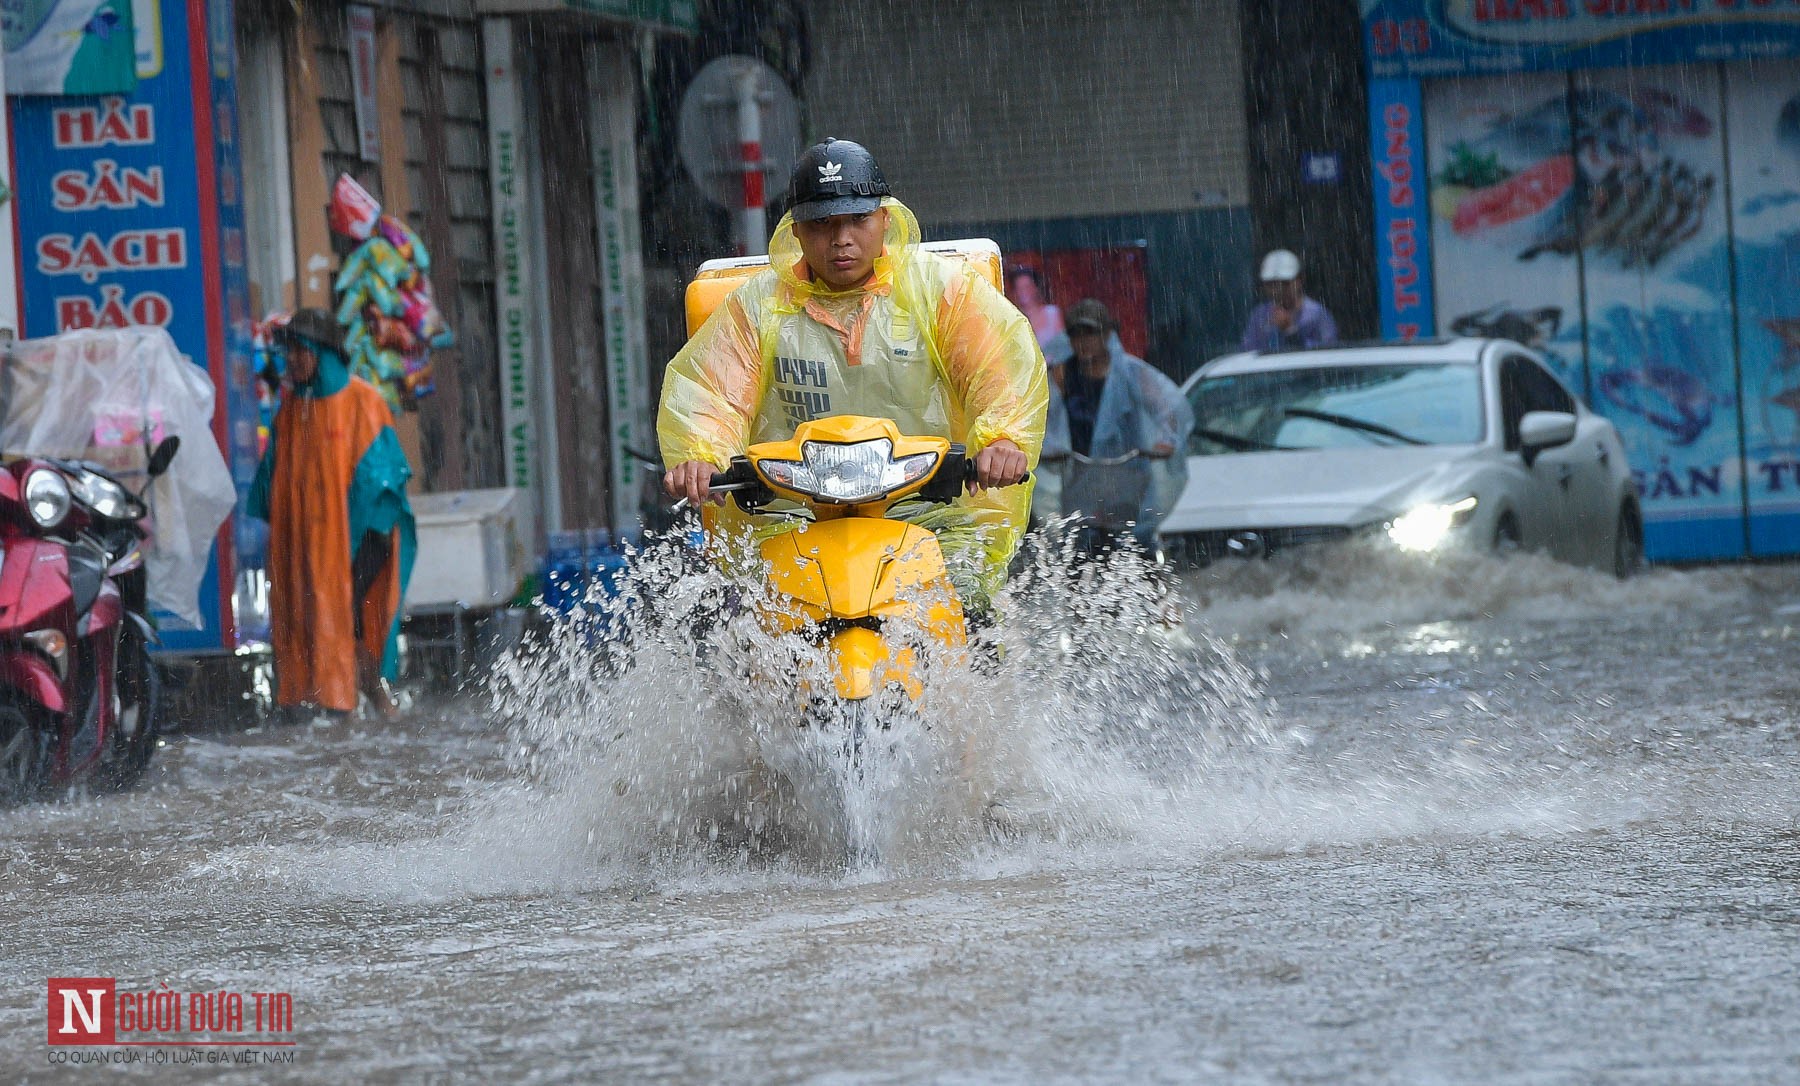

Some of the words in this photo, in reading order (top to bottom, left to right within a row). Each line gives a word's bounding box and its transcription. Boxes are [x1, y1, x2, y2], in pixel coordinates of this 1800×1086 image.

[1371, 18, 1431, 54] 93
[53, 97, 155, 149] HẢI
[52, 160, 164, 211] SẢN
[818, 175, 843, 184] adidas
[36, 228, 187, 283] SẠCH
[56, 284, 173, 330] BẢO
